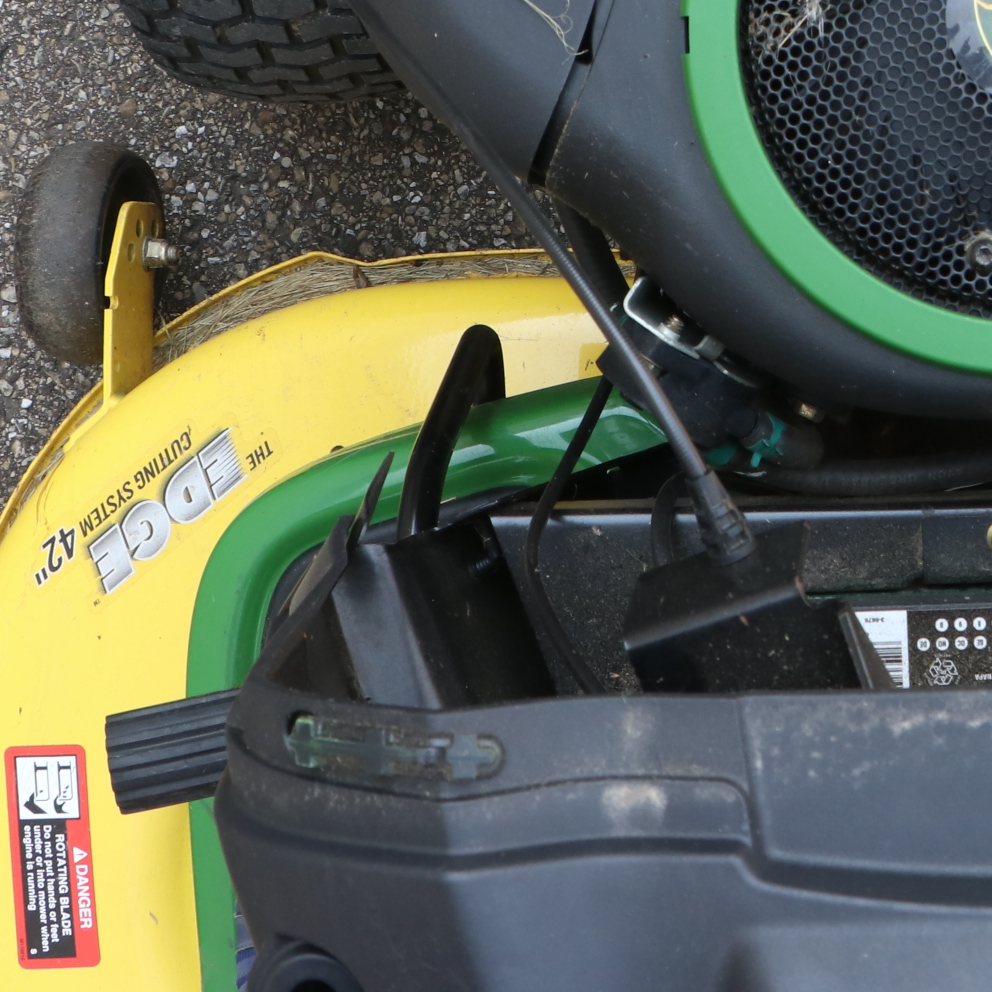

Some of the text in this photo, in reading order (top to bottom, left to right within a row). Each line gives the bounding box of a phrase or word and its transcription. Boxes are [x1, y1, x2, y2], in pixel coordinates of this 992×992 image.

[245, 440, 274, 471] THE
[34, 432, 192, 586] CUTTING SYSTEM 42"
[87, 428, 248, 594] EDGE
[23, 825, 34, 859] engine
[26, 861, 34, 870] is
[27, 873, 37, 911] running
[33, 825, 49, 952] under or into mower when
[43, 825, 60, 942] Do not put hands or feet
[55, 834, 72, 936] ROTATING BLADE
[75, 865, 92, 928] DANGER
